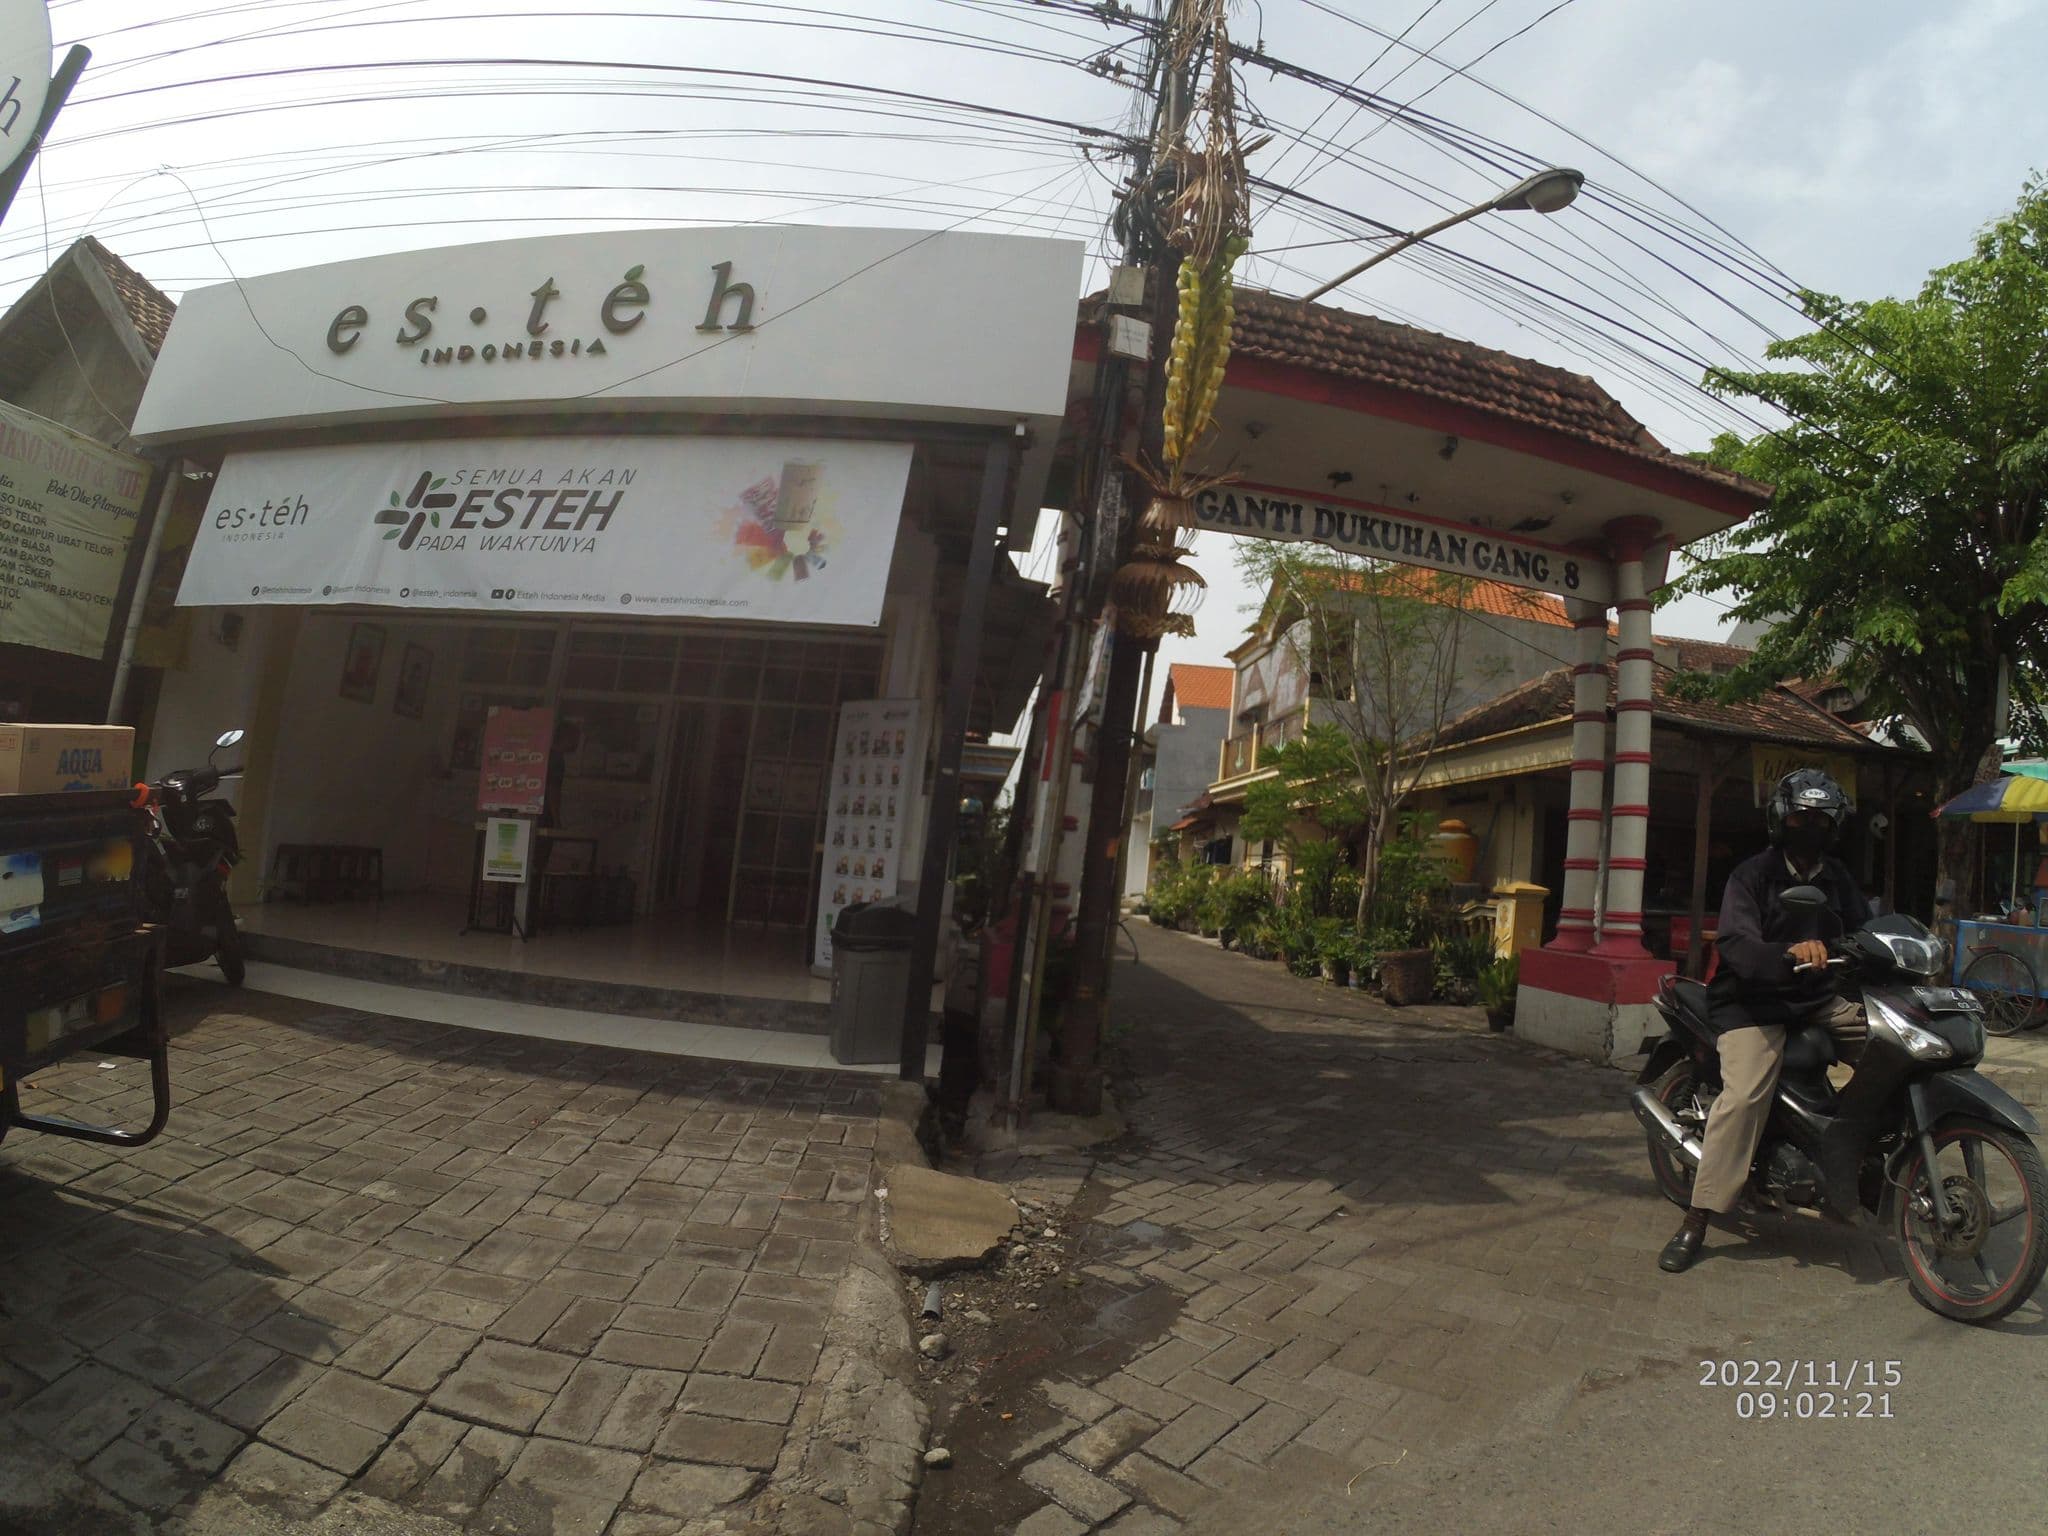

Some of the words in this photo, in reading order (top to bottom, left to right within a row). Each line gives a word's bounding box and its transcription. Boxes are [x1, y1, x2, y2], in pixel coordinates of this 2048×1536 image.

[420, 337, 607, 364] INDONESIA
[450, 468, 543, 486] SEMUA
[558, 468, 639, 486] AKAN
[0, 492, 15, 505] SO
[18, 499, 43, 513] URAT
[450, 488, 625, 531] ESTEH
[15, 510, 47, 527] TELOR
[13, 523, 57, 541] CAMPUR
[57, 535, 82, 548] URAT
[84, 542, 115, 557] TELOR
[222, 532, 285, 543] INDONESIA
[416, 535, 467, 551] PADA
[480, 535, 596, 553] WAKTUNYA
[1196, 488, 1303, 535] GANTI
[1314, 506, 1467, 566] DUKUHAN
[1564, 561, 1580, 590] 8
[21, 539, 52, 555] BIASA
[20, 550, 54, 568] BAKSO
[19, 563, 52, 579] CEKER
[17, 576, 58, 594] CAMPUR
[59, 587, 92, 602] BAKSO
[539, 591, 580, 601] Indonesia
[581, 592, 606, 602] Media
[56, 748, 104, 778] AQUA
